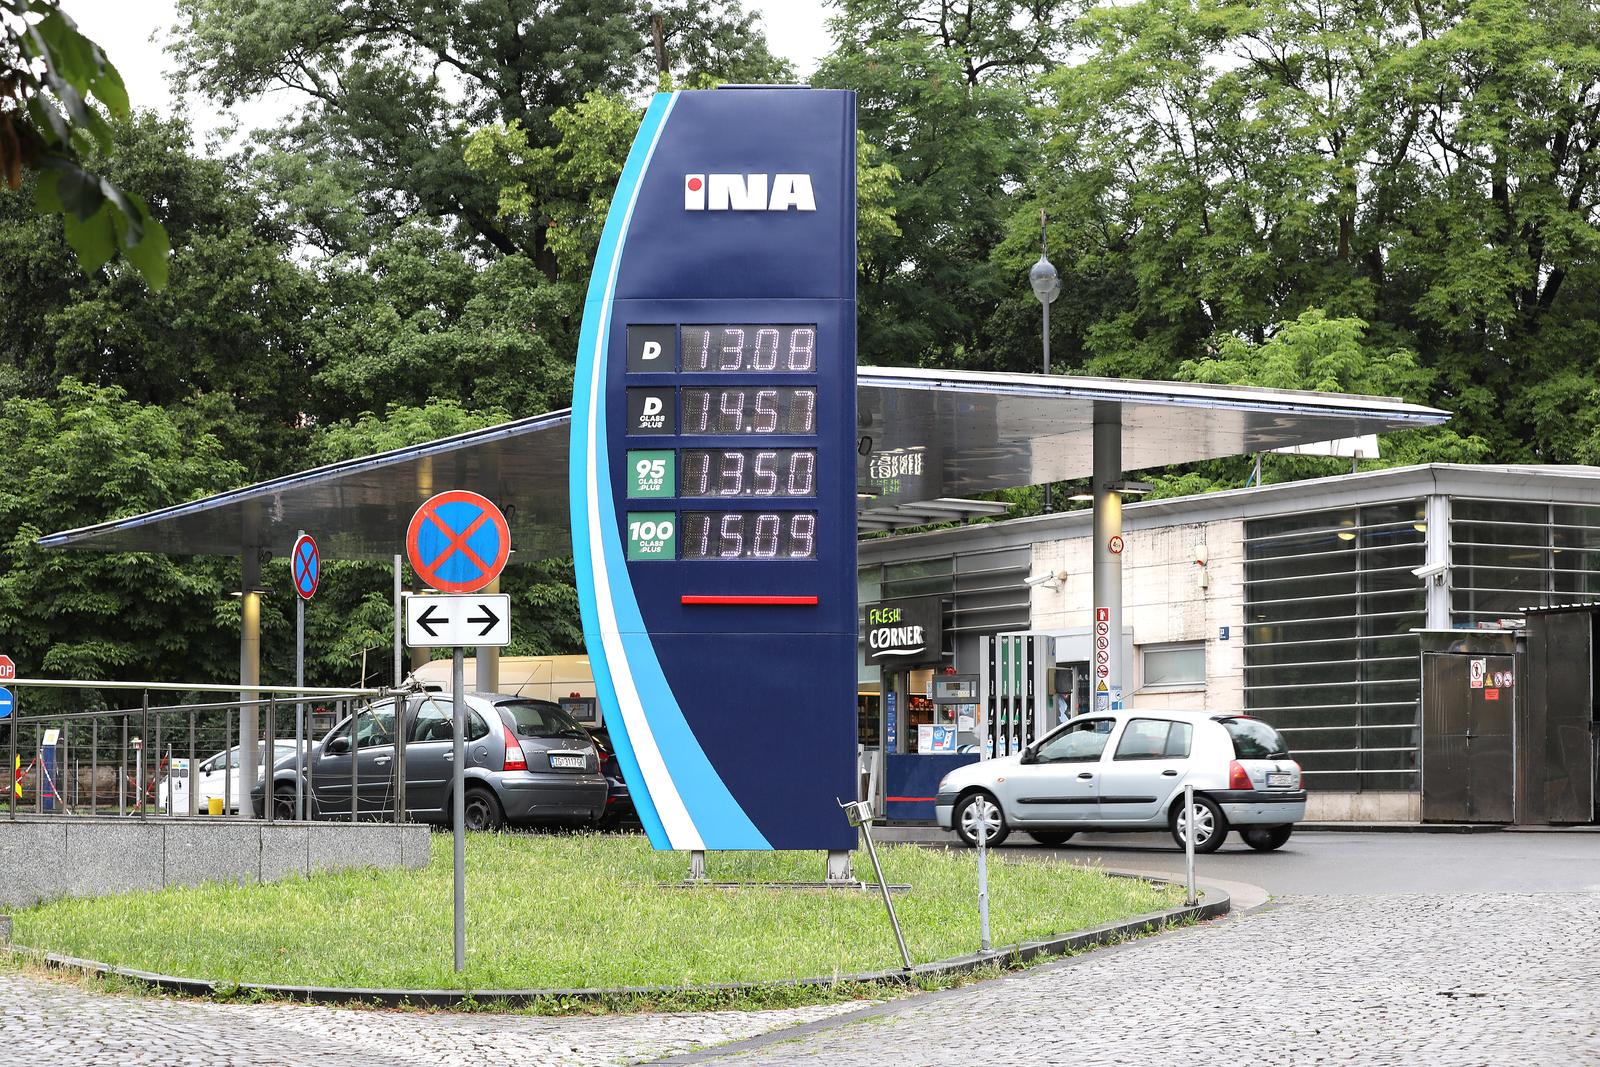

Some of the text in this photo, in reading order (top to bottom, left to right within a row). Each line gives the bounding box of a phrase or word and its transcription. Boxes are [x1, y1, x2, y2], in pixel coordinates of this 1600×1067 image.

[641, 341, 662, 360] D
[700, 328, 815, 371] 13.08
[643, 397, 663, 416] D
[700, 390, 815, 433] 14.57
[636, 459, 666, 479] 95
[699, 452, 815, 495] 13.50
[629, 521, 674, 541] 100
[700, 514, 816, 557] 15.09
[0, 665, 13, 677] OP
